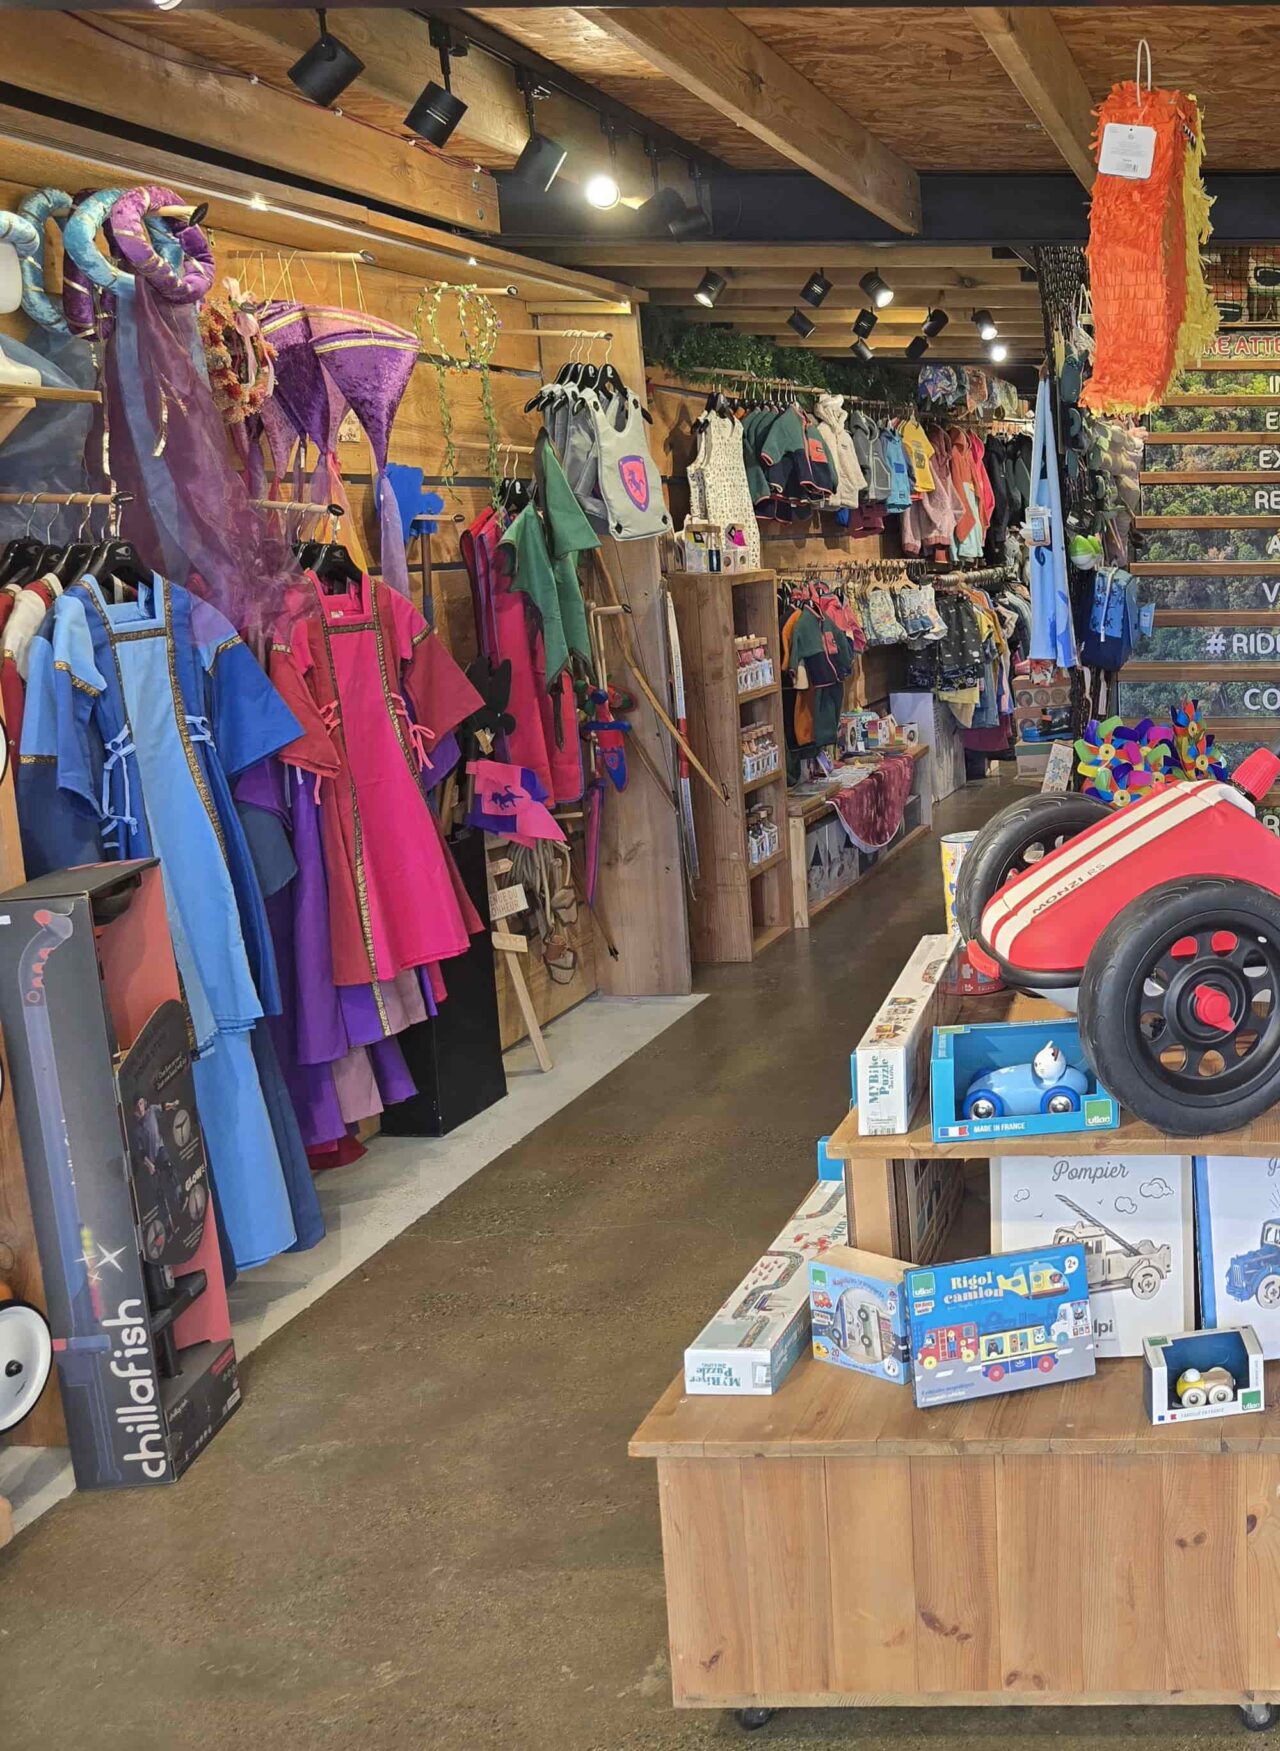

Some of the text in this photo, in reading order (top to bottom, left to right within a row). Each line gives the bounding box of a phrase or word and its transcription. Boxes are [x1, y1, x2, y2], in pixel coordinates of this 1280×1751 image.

[1032, 863, 1106, 914] MONZI RS
[879, 1058, 890, 1095] Puzzle
[973, 1121, 1025, 1134] MADE IN FRANCE
[1051, 1160, 1129, 1184] Pompier
[1066, 1259, 1077, 1269] 2+
[951, 1271, 993, 1290] Rigol
[943, 1286, 1004, 1305] camion
[1093, 1319, 1113, 1337] lpi
[696, 1367, 733, 1377] Puzzle
[101, 1298, 167, 1478] chillafish
